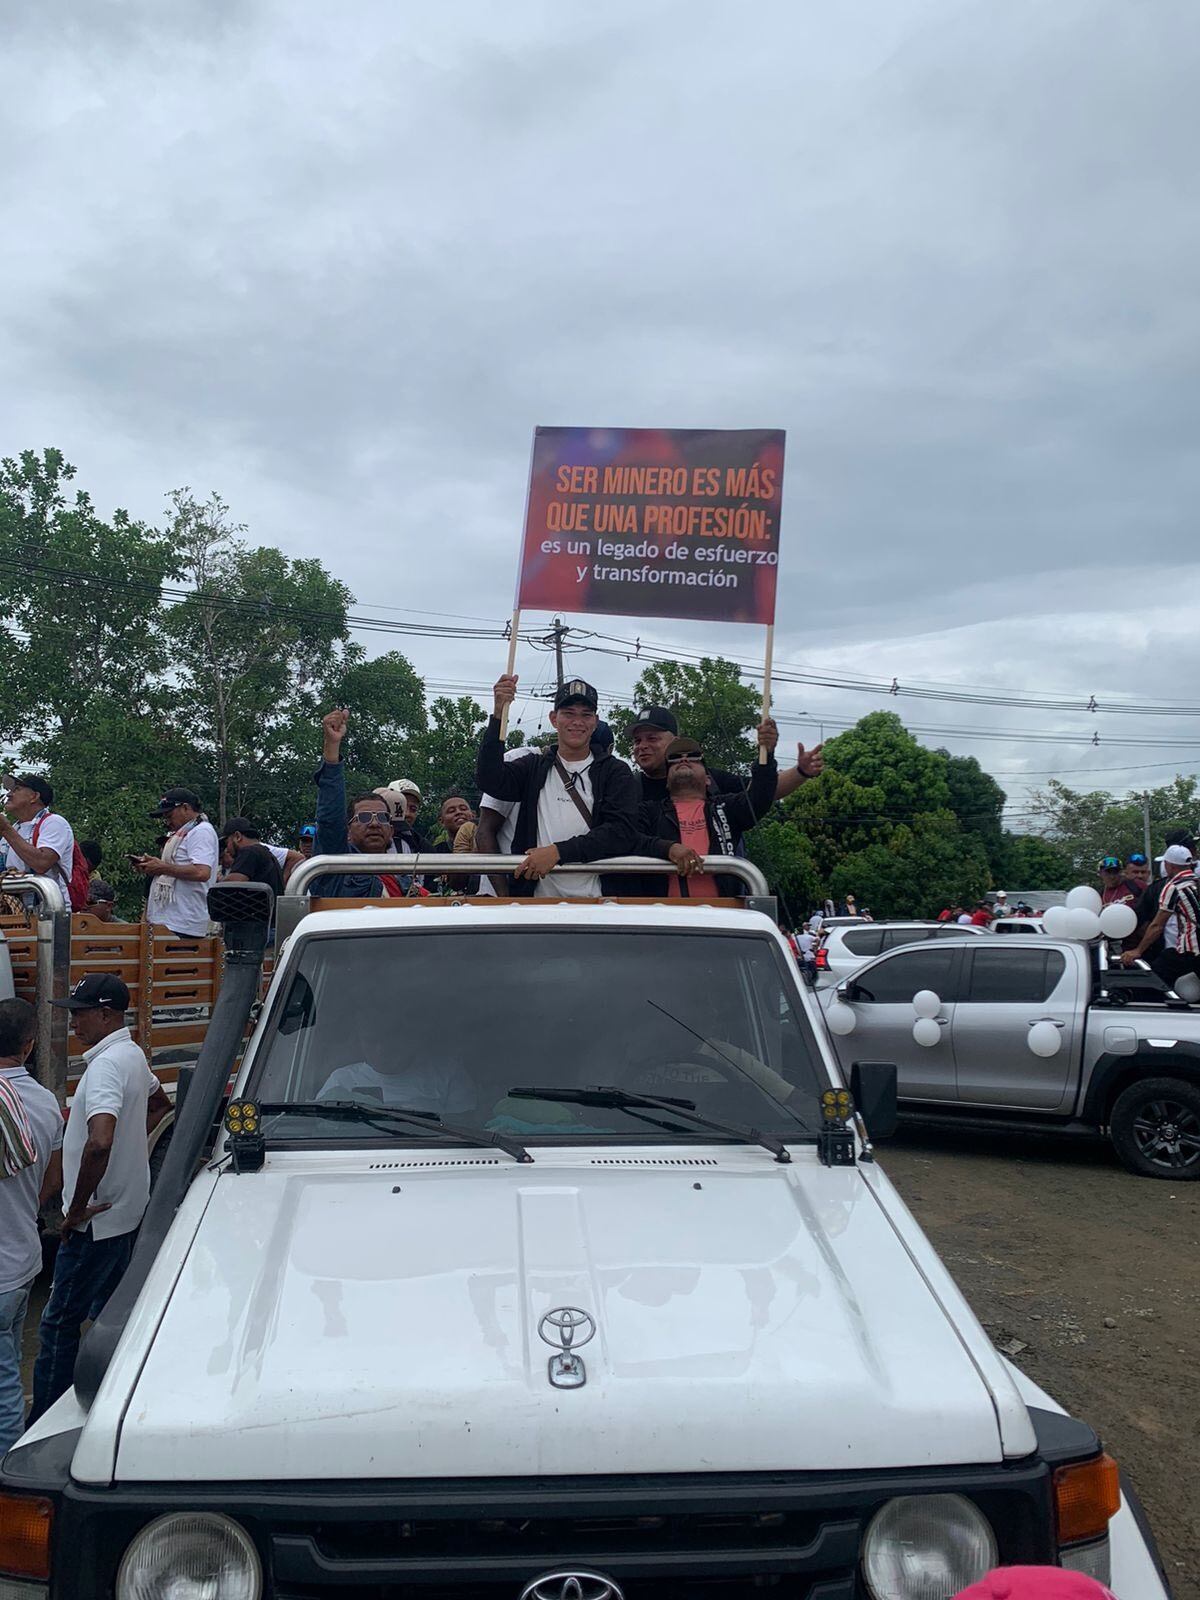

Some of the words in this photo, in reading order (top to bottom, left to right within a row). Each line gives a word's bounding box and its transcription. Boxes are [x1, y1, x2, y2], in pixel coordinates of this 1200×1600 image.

[556, 464, 598, 494] SER
[603, 466, 688, 496] MINERO
[692, 467, 720, 496] ES
[725, 462, 775, 500] MÁS
[546, 501, 589, 532] QUE
[594, 504, 638, 533] UNA
[643, 502, 772, 540] PROFESIÓN:
[540, 540, 561, 554] es
[567, 540, 591, 555] un
[597, 538, 659, 560] legado
[664, 541, 689, 560] de
[694, 544, 778, 565] esfuerzo
[576, 565, 588, 583] y
[593, 563, 738, 588] transformación
